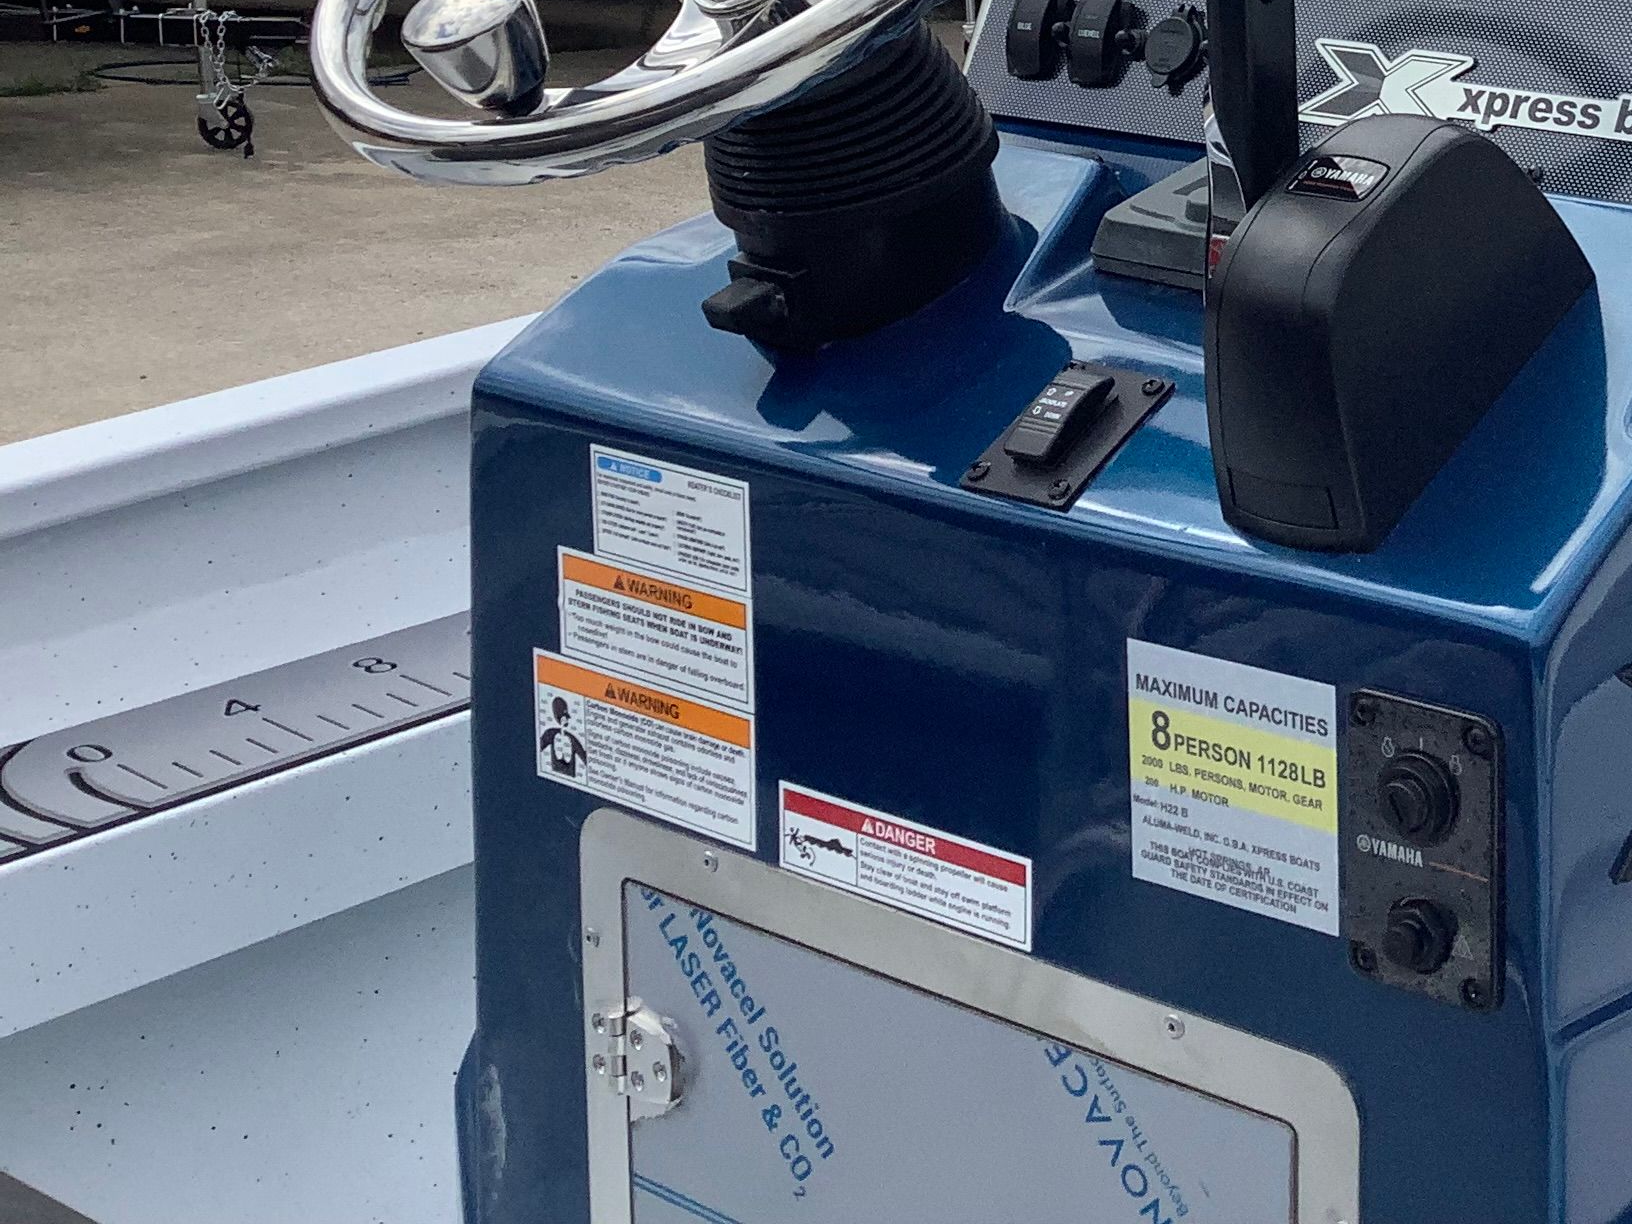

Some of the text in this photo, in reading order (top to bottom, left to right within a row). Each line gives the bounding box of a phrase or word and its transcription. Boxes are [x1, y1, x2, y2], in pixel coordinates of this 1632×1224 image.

[1456, 85, 1601, 130] xpress
[1325, 169, 1375, 186] YAMAHA
[627, 577, 692, 610] WARNING
[352, 656, 399, 674] 8
[223, 697, 262, 718] 4
[617, 686, 679, 719] WARNING
[1135, 672, 1328, 737] MAXIMUM CAPACITIES
[1151, 708, 1170, 751] 8
[1173, 733, 1251, 770] PERSON
[1190, 788, 1229, 806] MOTOR
[1292, 793, 1322, 810] GEAR
[875, 820, 935, 855] DANGER
[1372, 838, 1423, 867] YAMAHA
[658, 913, 722, 1018] LASER
[716, 1017, 767, 1098] Fiber
[761, 1104, 782, 1132] &
[690, 908, 834, 1160] Novacel Solution
[1089, 1057, 1127, 1114] Surfac
[1124, 1116, 1148, 1152] The
